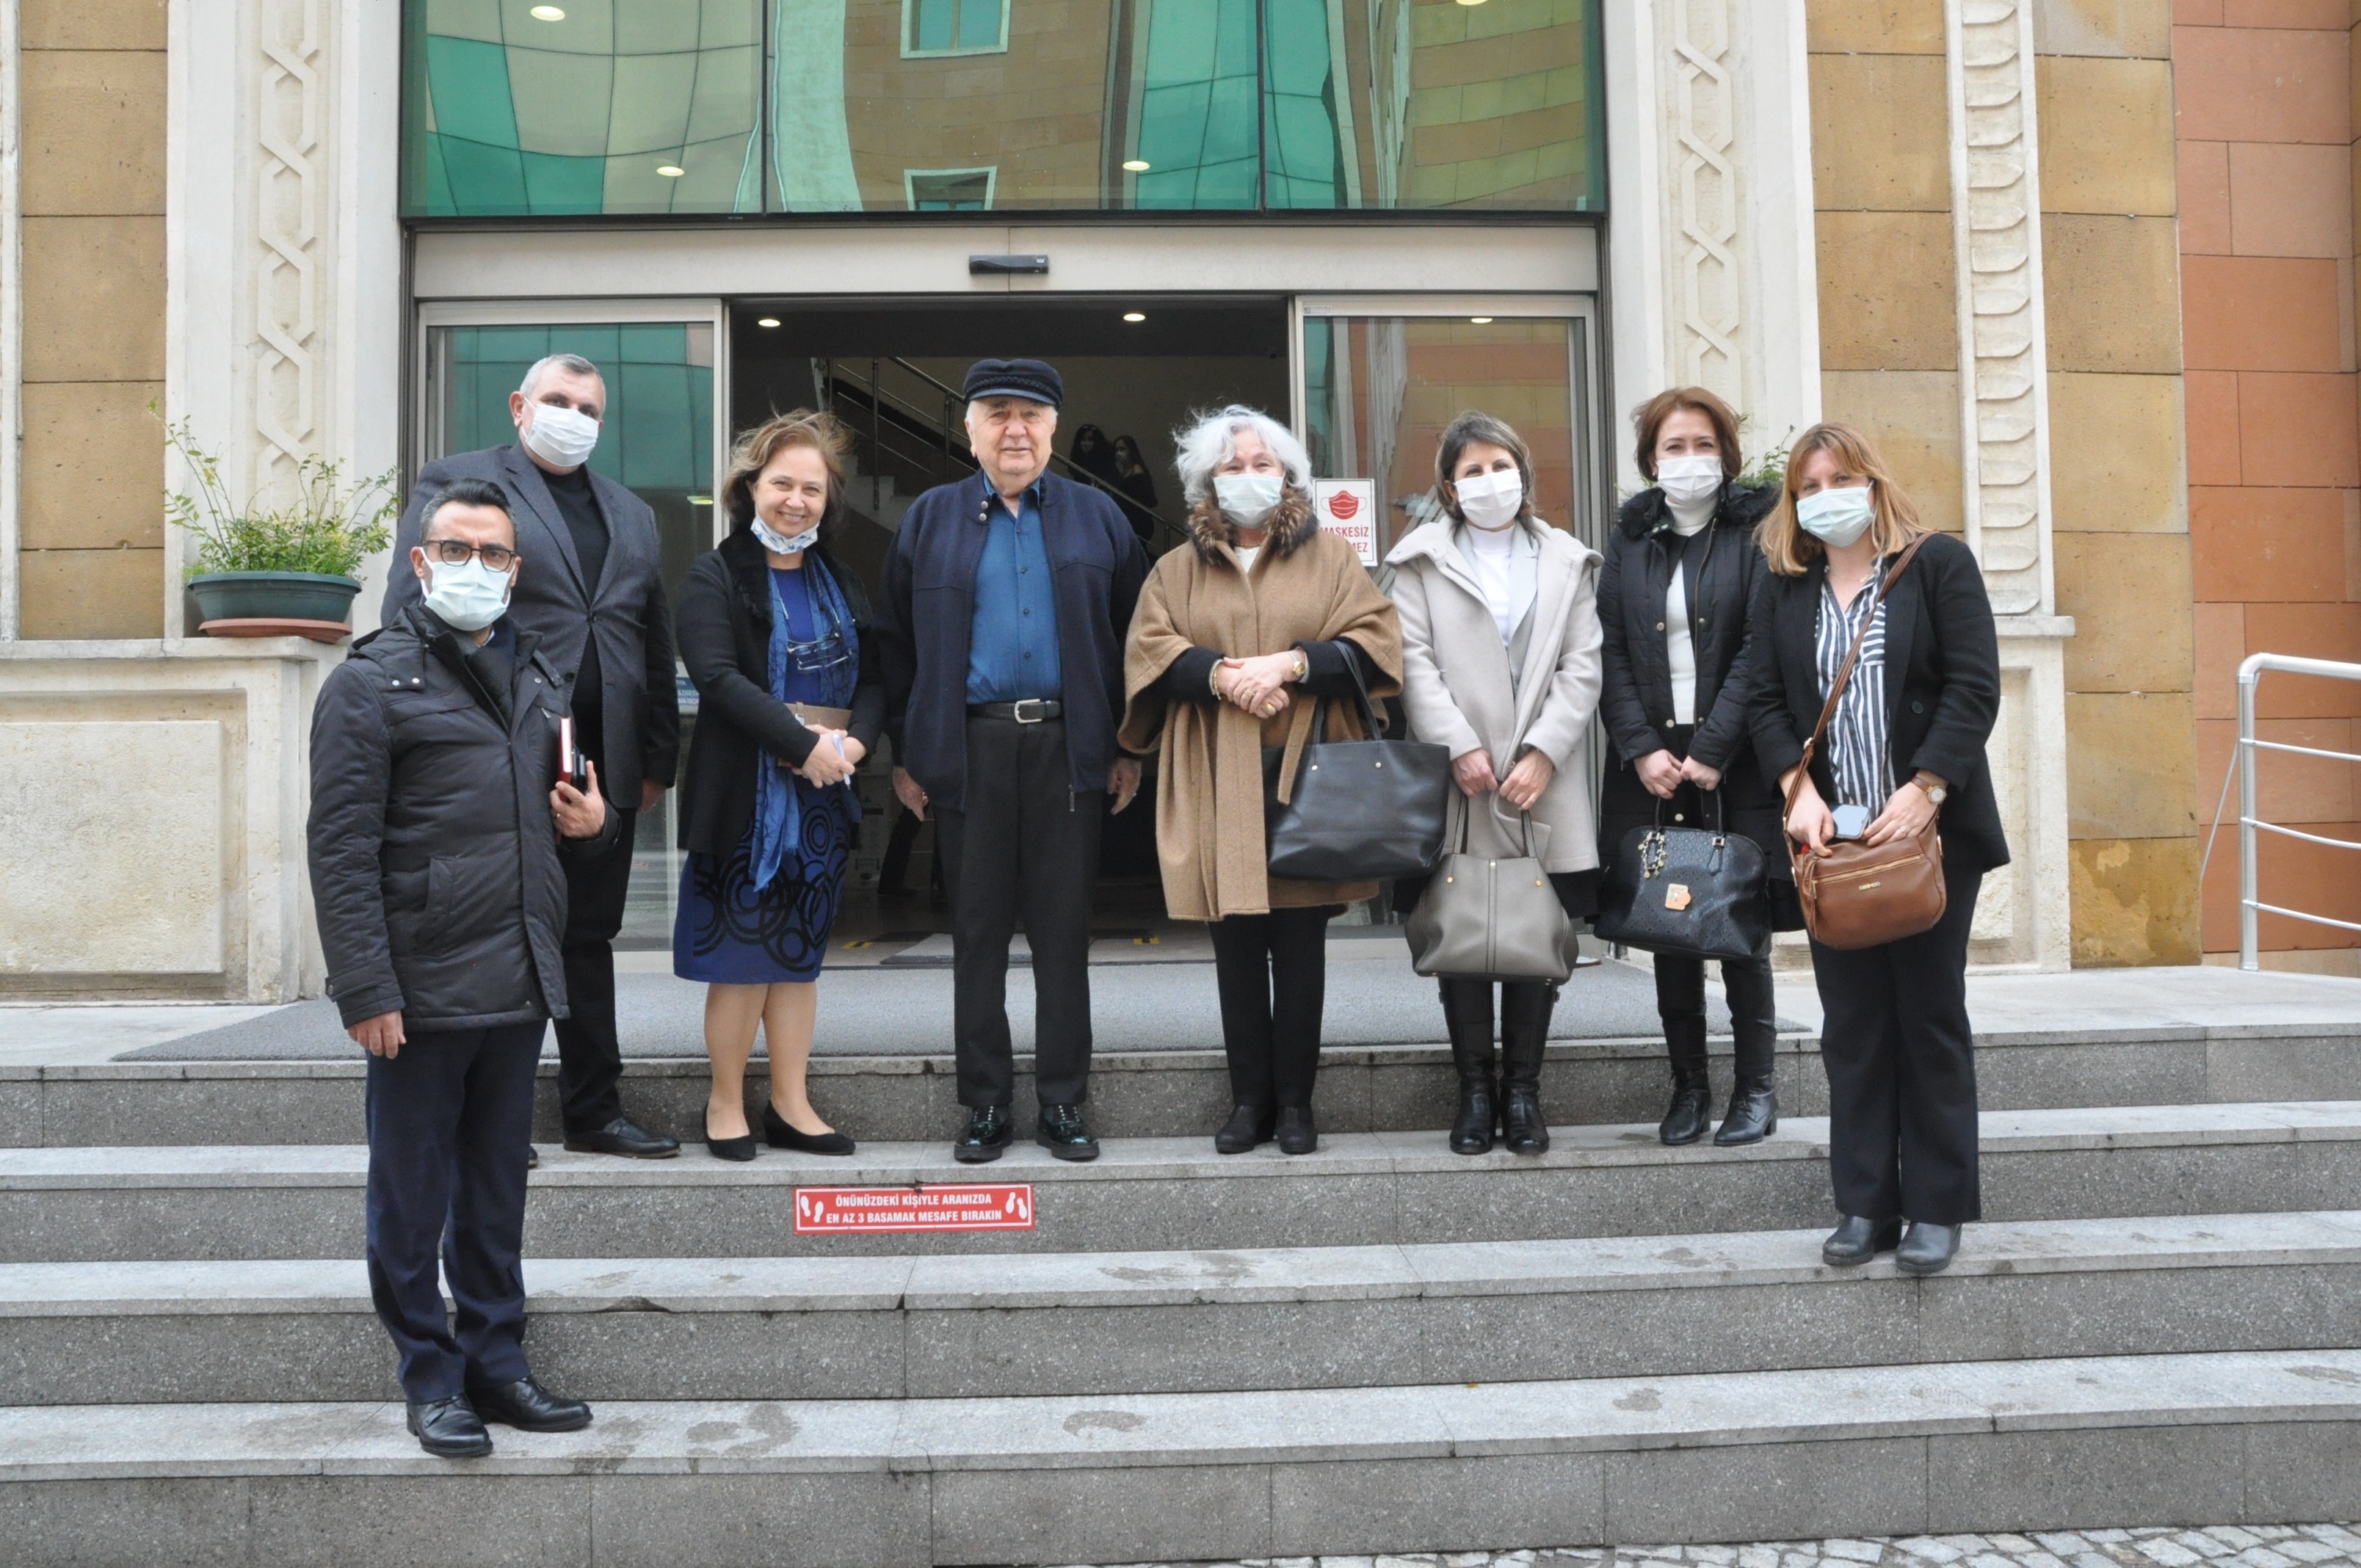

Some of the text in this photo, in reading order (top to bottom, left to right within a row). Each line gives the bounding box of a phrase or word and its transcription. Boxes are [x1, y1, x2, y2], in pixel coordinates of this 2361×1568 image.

[835, 1194, 992, 1208] ÖNÜNÜZDEKİ KİŞİYLE ARANIZDA
[826, 1210, 1002, 1224] EN AZ 3 BASAMAK MESAFE BIRAKIN
